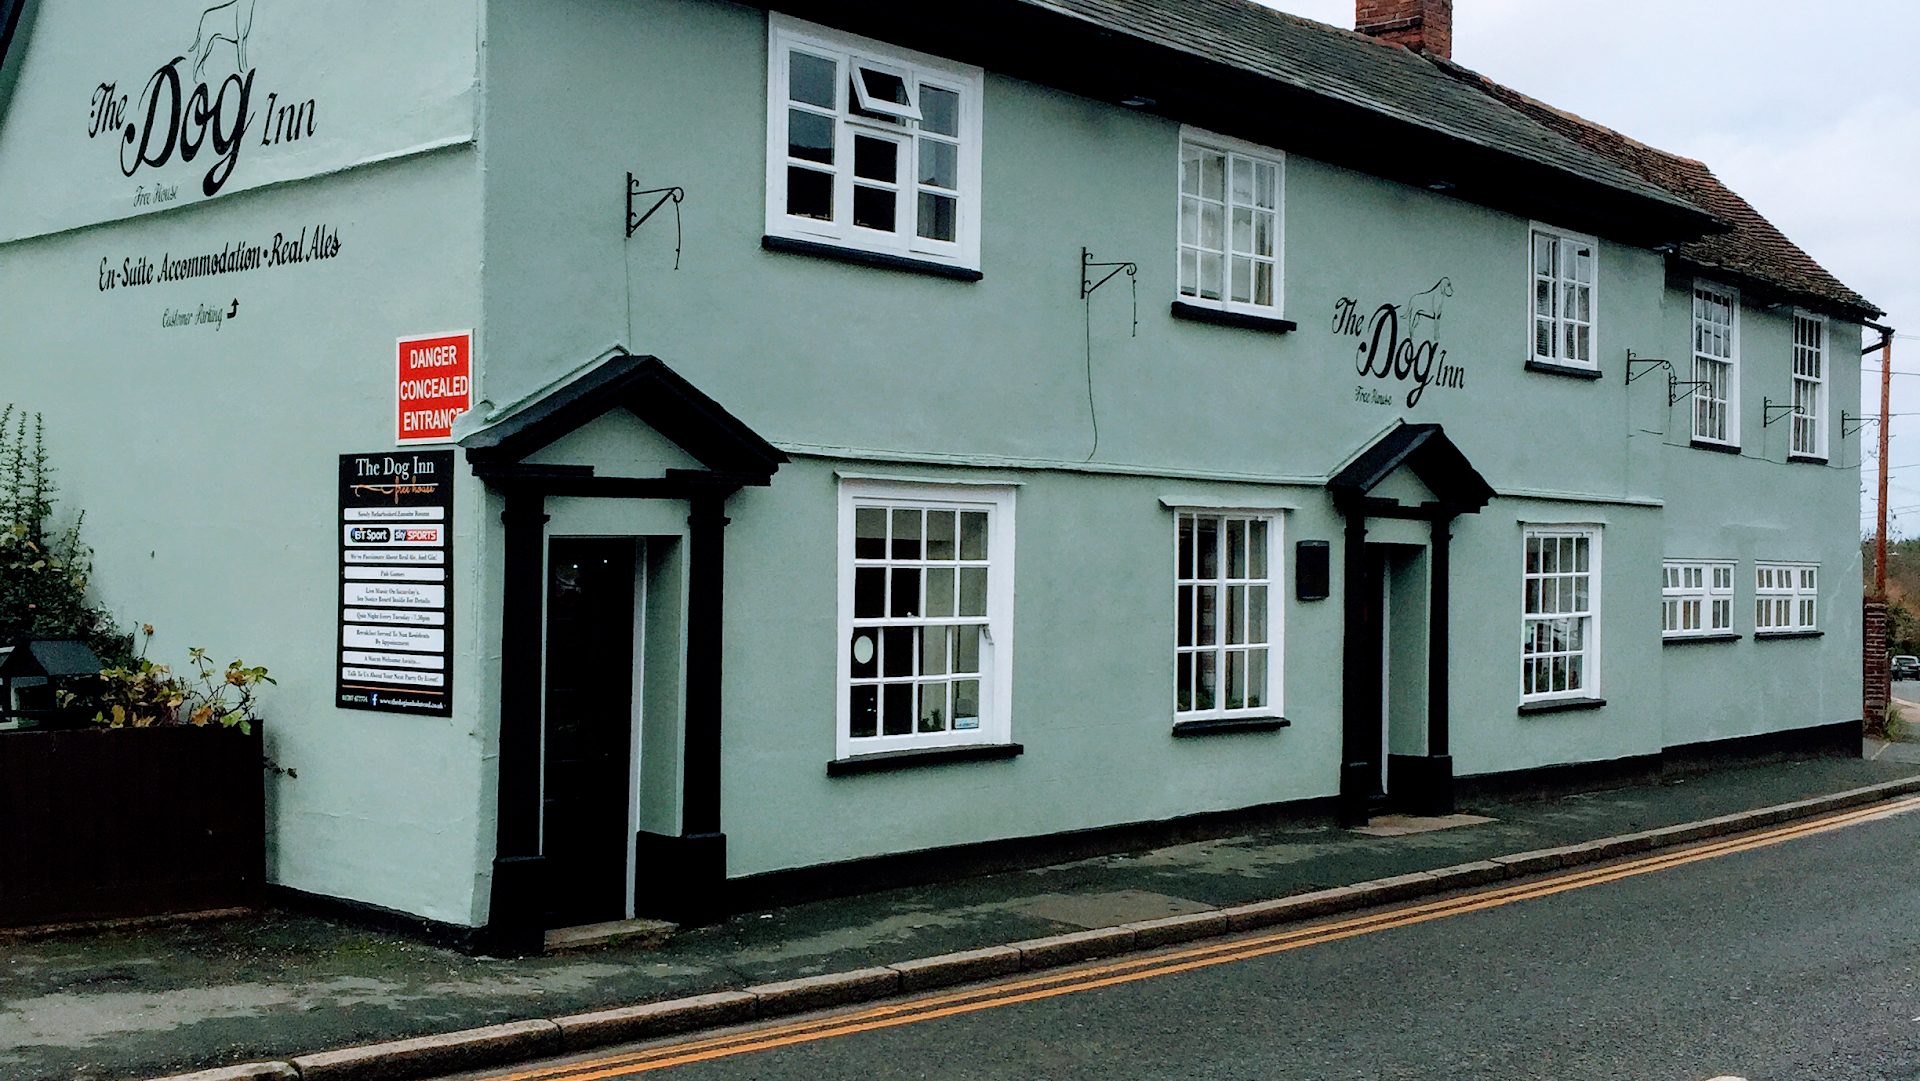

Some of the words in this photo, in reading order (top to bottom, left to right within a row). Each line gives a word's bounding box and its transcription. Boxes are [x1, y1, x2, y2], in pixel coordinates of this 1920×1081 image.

[88, 80, 127, 138] The
[120, 56, 256, 197] Dog
[260, 92, 317, 147] Inn
[133, 186, 151, 207] Free
[152, 182, 178, 204] House
[99, 256, 154, 292] En-Suite
[157, 241, 260, 283] Accommodation
[268, 226, 306, 267] Real
[305, 223, 342, 262] Ales
[162, 308, 193, 328] Customer
[194, 303, 223, 331] Parking
[410, 345, 457, 369] DANGER
[1332, 297, 1364, 337] The
[1356, 303, 1439, 409] Dog
[1435, 349, 1465, 389] Inn
[400, 375, 468, 401] CONCEALED
[1355, 386, 1369, 404] Free
[1372, 389, 1392, 406] House
[403, 407, 464, 431] ENTRANC
[355, 458, 380, 476] The
[383, 457, 410, 480] Dog
[413, 456, 435, 474] Inn
[354, 530, 367, 540] BT
[367, 529, 388, 542] Sport
[394, 530, 407, 541] sky
[406, 530, 437, 541] SPORTS
